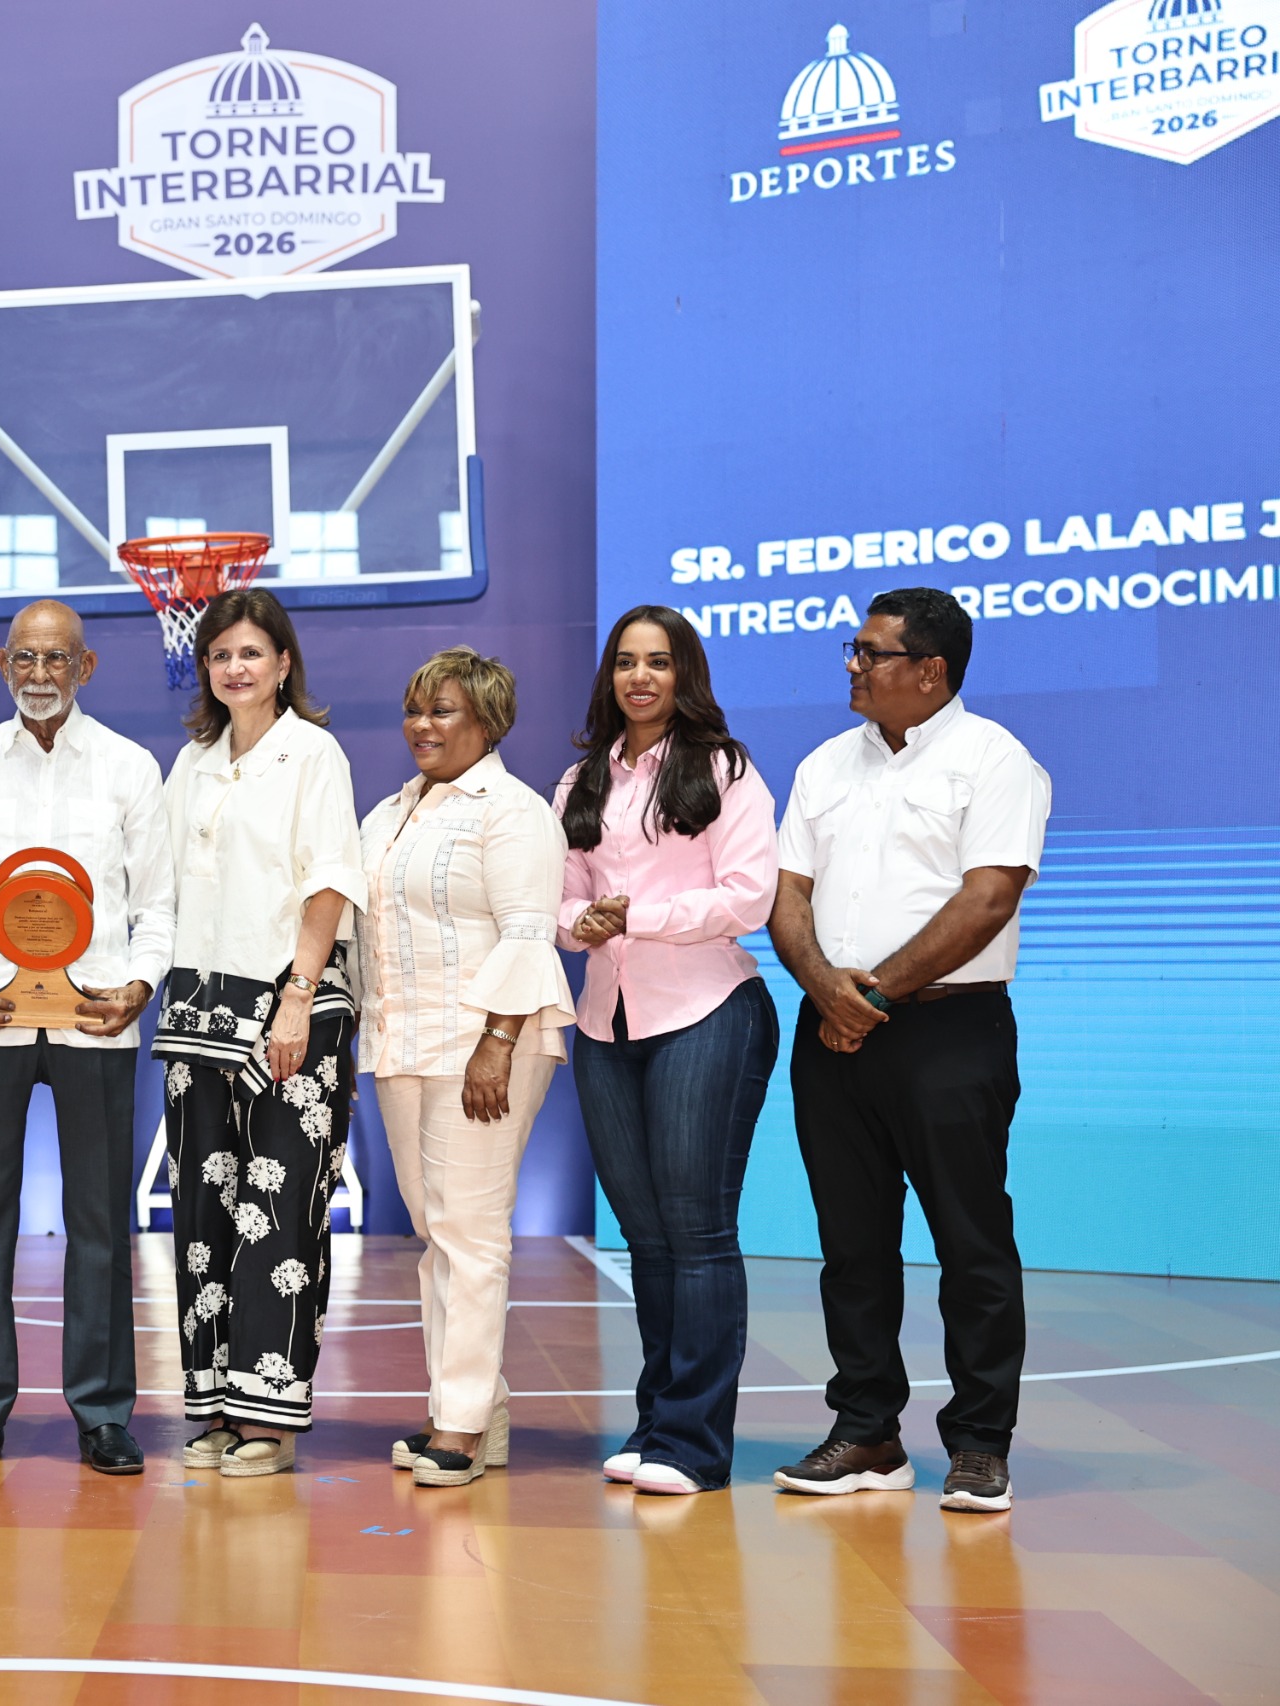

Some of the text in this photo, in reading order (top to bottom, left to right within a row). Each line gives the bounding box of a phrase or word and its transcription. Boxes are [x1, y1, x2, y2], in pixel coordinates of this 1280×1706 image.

[1109, 25, 1267, 69] TORNEO
[161, 125, 356, 161] TORNEO
[1151, 110, 1219, 136] 2026
[82, 162, 435, 211] INTERBARRIAL
[729, 139, 958, 203] DEPORTES
[150, 210, 362, 233] GRAN SANTO DOMINGO
[213, 231, 296, 256] 2026
[670, 545, 746, 584] SR.
[757, 521, 1011, 577] FEDERICO
[1025, 502, 1247, 556] LALANE
[672, 594, 861, 638] NTREGA
